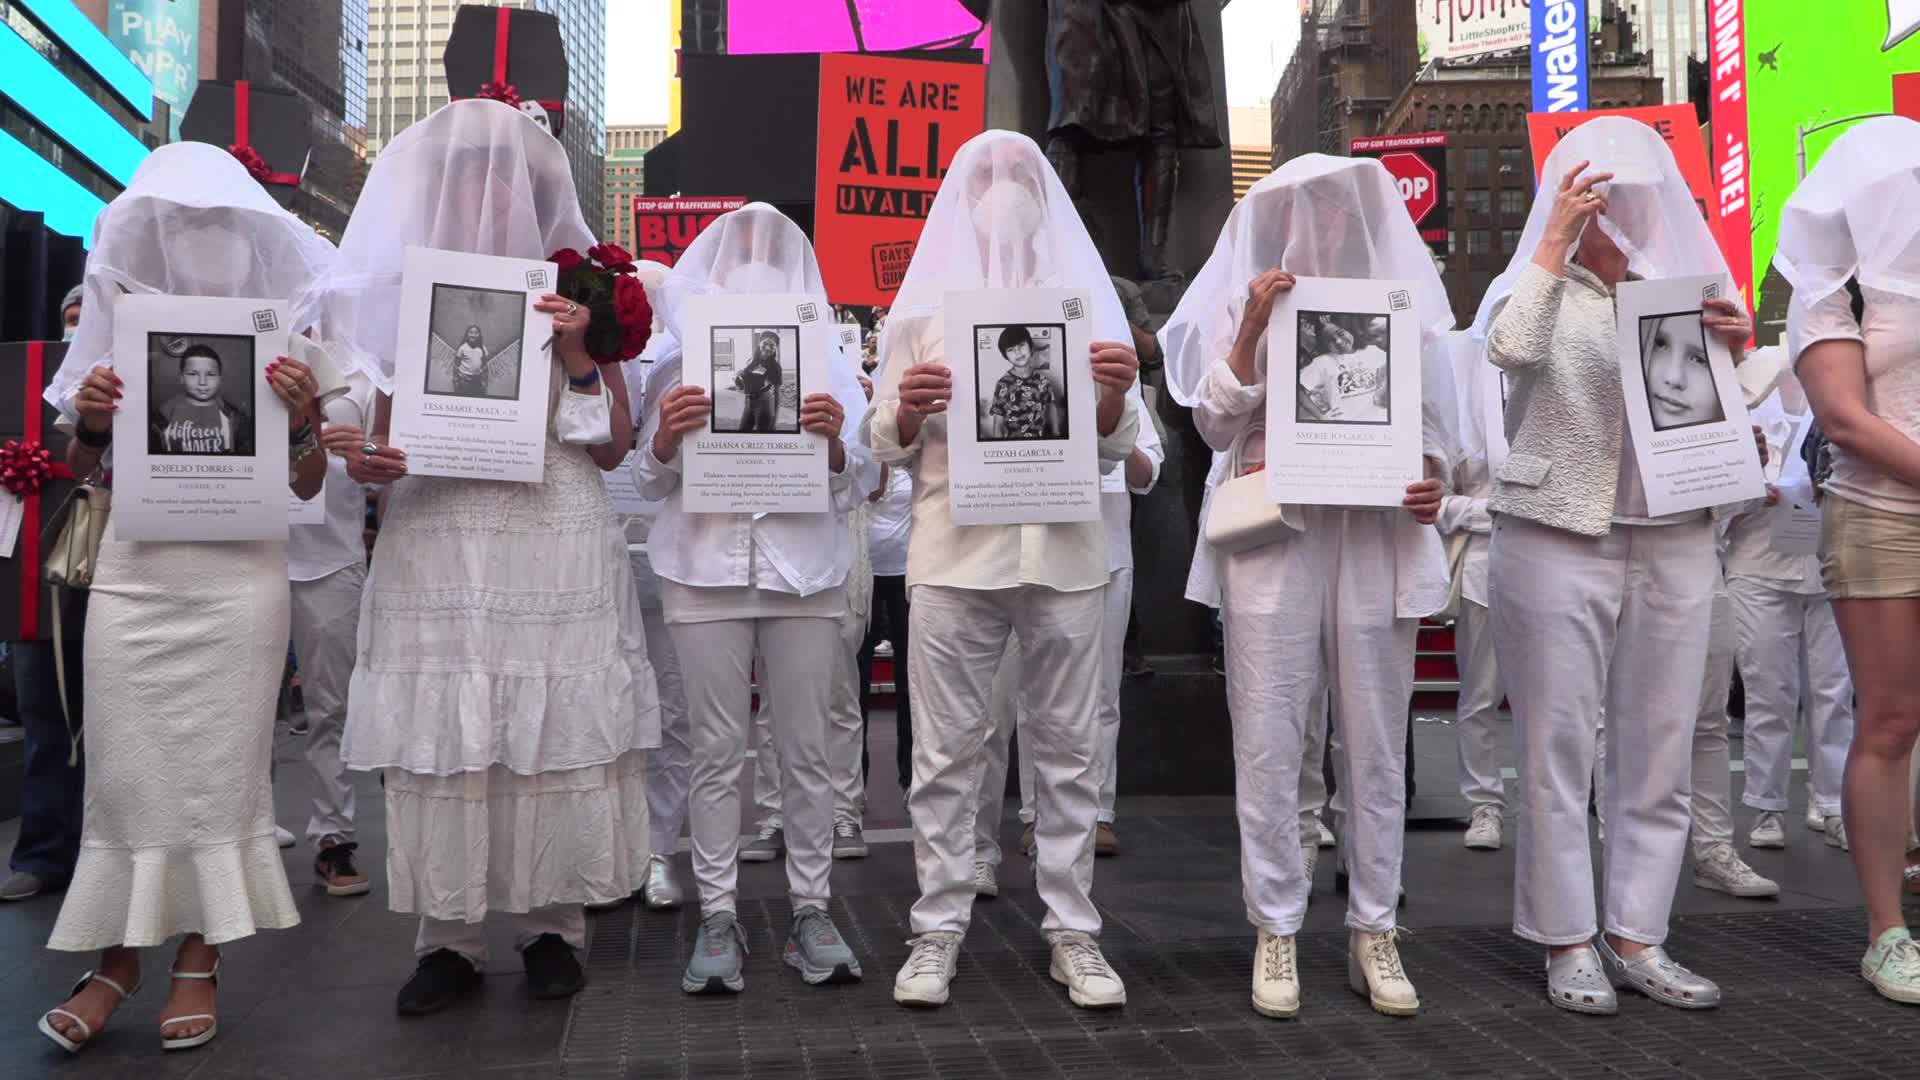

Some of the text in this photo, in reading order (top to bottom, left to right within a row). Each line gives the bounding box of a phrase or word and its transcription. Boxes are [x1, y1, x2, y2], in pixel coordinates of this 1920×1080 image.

[1539, 0, 1578, 112] wate
[846, 75, 960, 112] WE ARE
[839, 116, 949, 179] ALL
[1353, 141, 1368, 150] STOP
[1370, 140, 1383, 148] GUN
[1385, 137, 1424, 147] TRAFFICKING
[1397, 177, 1429, 201] OP
[637, 201, 744, 210] STOP GUN TRAFFICKING NOW!
[840, 188, 936, 216] UVALD
[880, 247, 911, 262] GAYS
[424, 402, 443, 411] TESS
[445, 404, 472, 413] MARIE
[475, 406, 500, 416] MATA
[697, 441, 739, 449] ELIAHANA
[741, 441, 764, 449] CRUZ
[766, 441, 798, 450] TORRES
[983, 450, 1016, 458] UZIYAH
[1018, 449, 1051, 457] GARCIA
[196, 464, 233, 473] TORRES
[244, 464, 254, 473] 10
